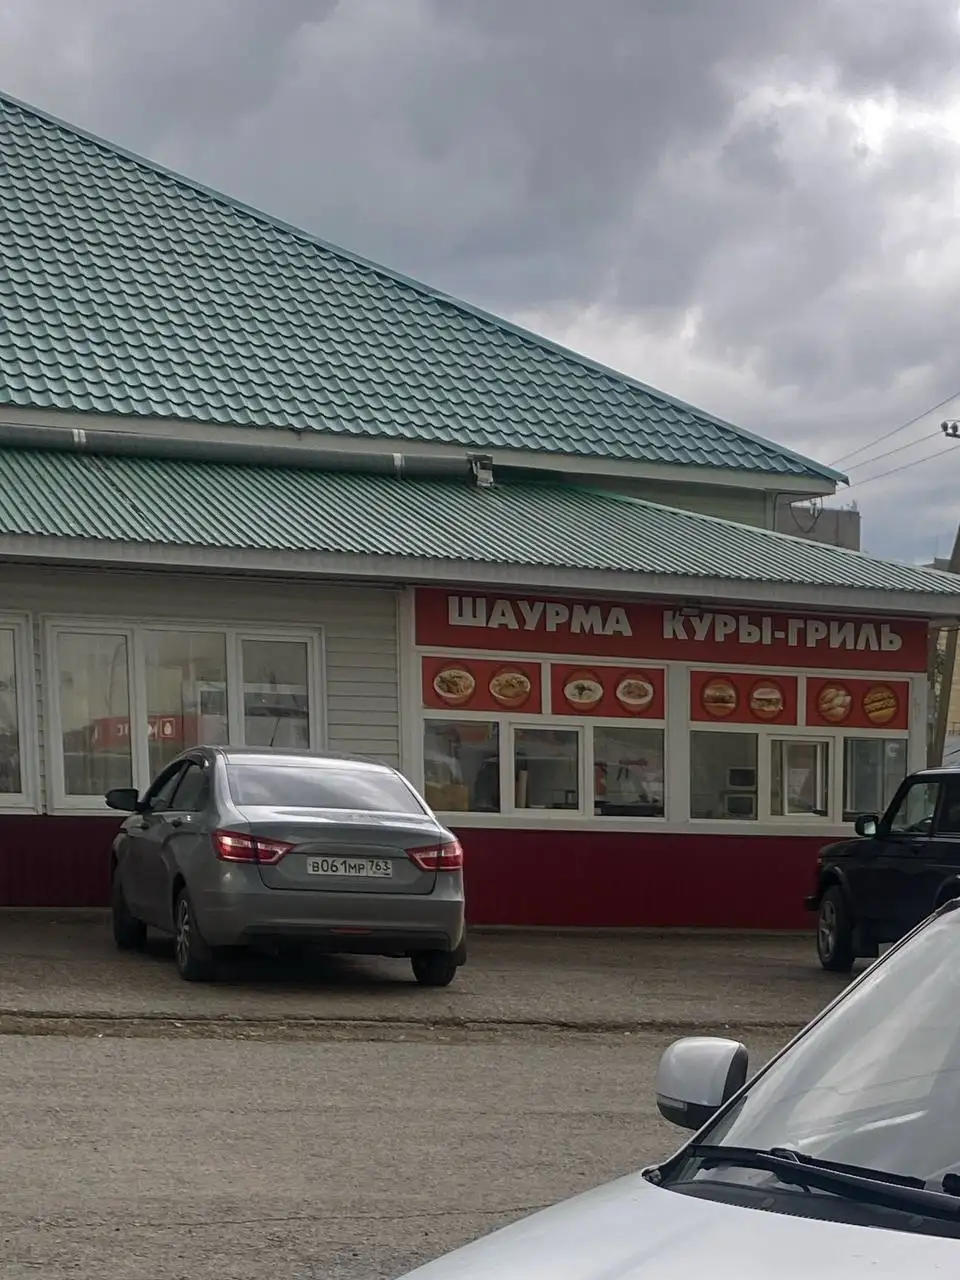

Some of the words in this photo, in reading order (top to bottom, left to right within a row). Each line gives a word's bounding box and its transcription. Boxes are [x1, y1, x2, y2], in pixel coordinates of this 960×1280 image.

[448, 596, 633, 637] ШАУРМА
[662, 610, 902, 652] КУРЫ-ГРИЛЬ
[311, 859, 366, 874] В061МР
[368, 860, 391, 872] 763
